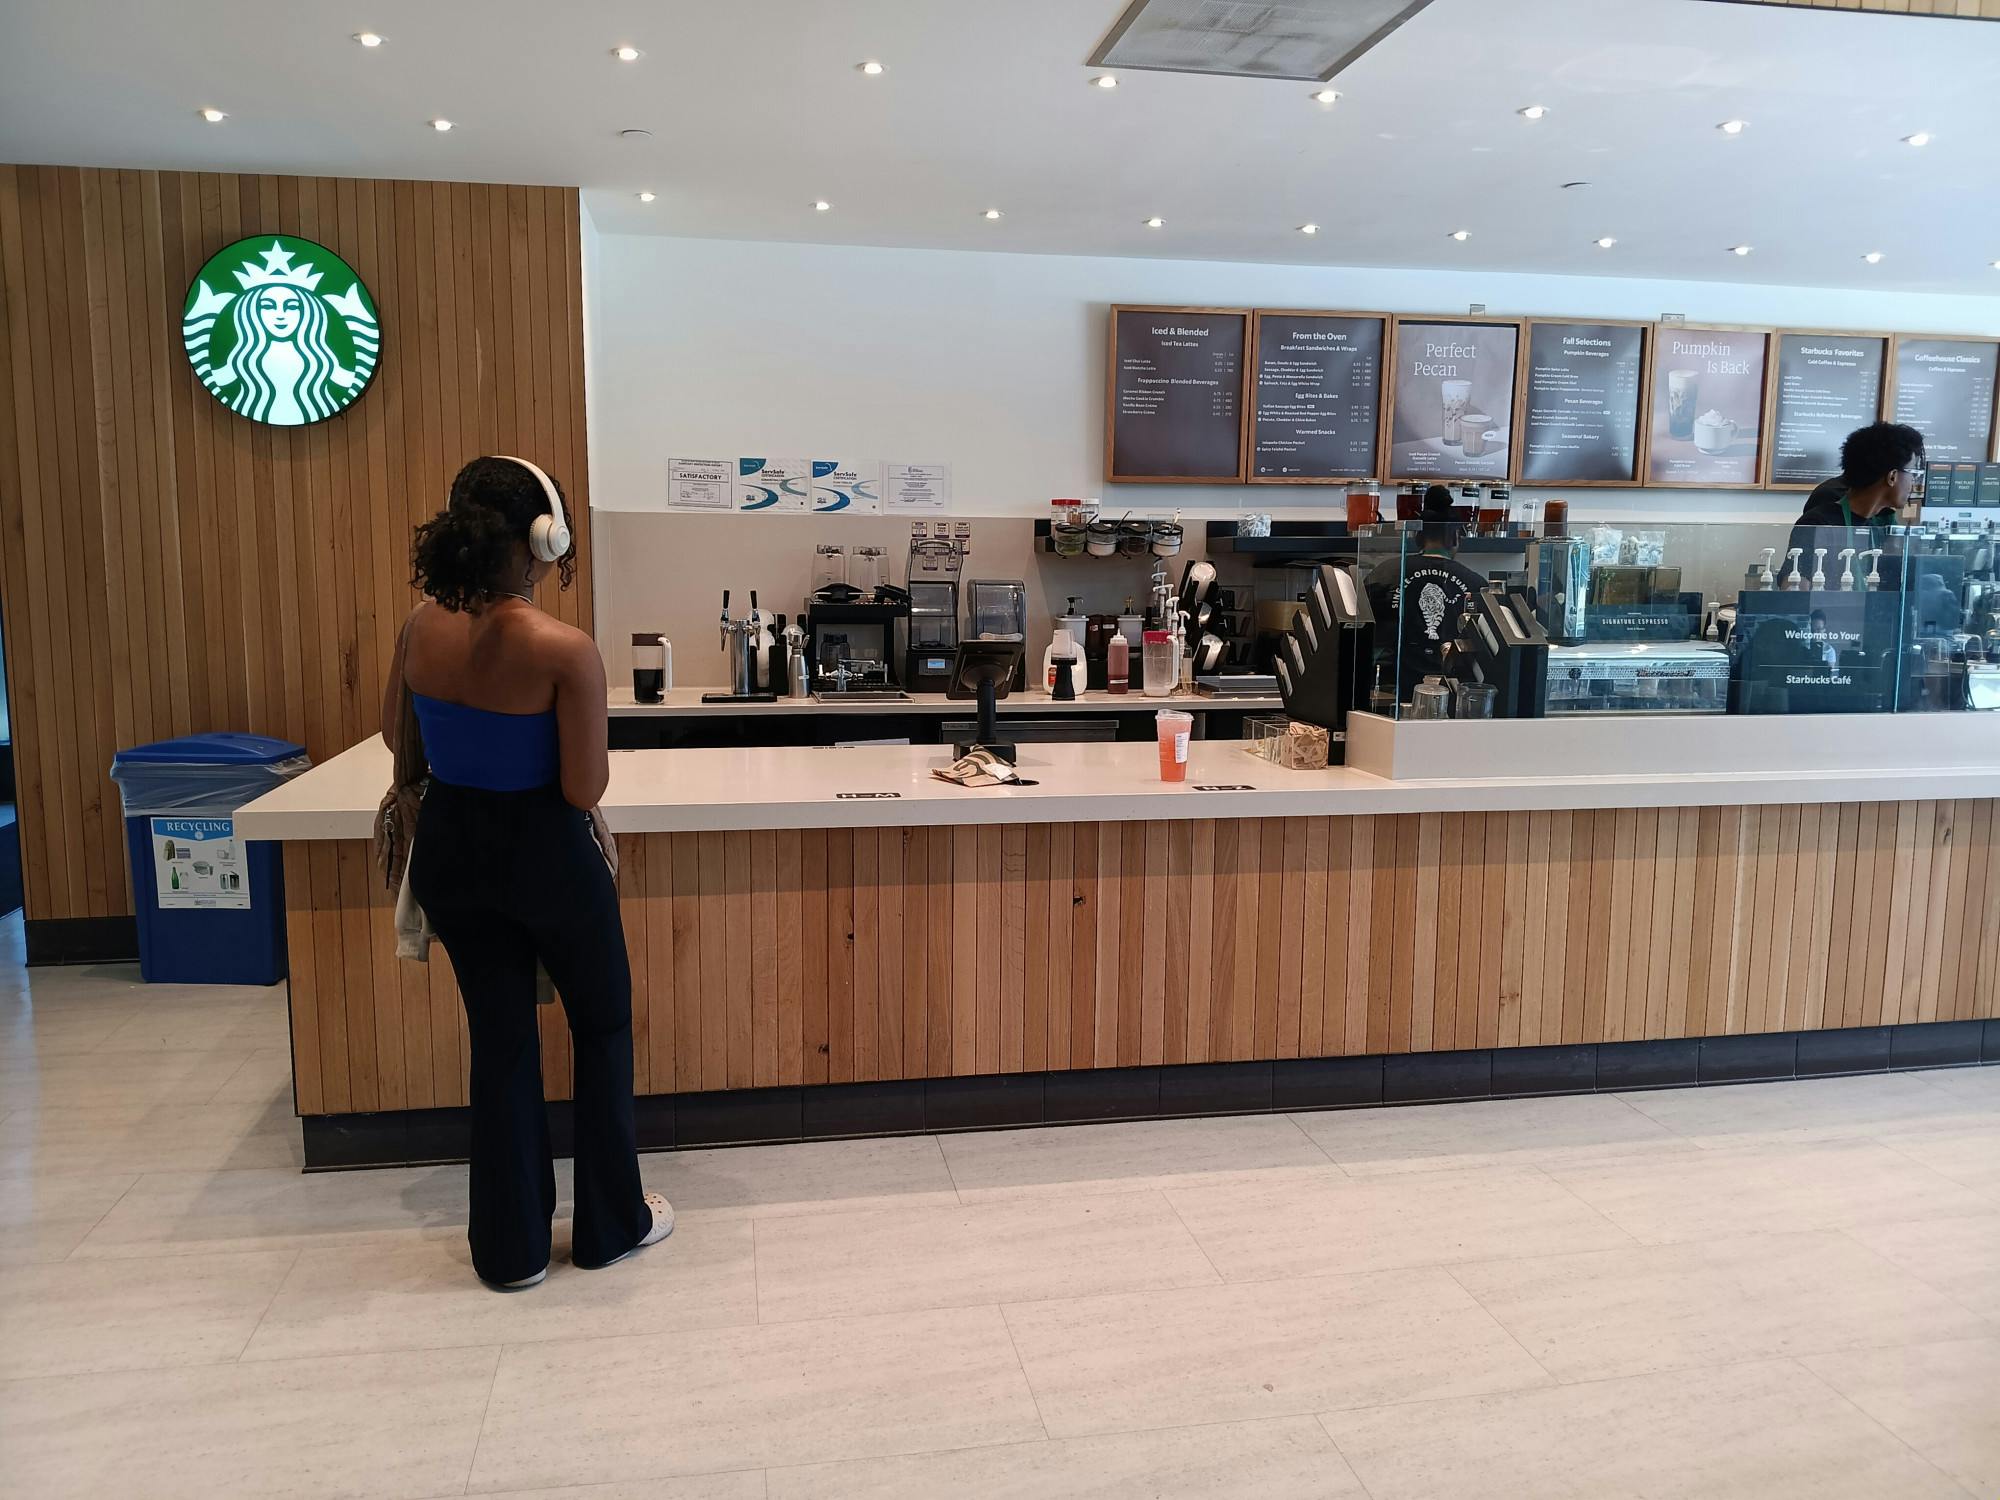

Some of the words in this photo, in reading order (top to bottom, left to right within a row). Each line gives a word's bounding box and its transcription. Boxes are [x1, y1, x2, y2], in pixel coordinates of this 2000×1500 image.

[1151, 327, 1168, 335] Iced
[1177, 328, 1209, 336] Blended
[1292, 332, 1312, 340] From
[1313, 332, 1326, 340] the
[1327, 333, 1347, 341] Oven
[1563, 337, 1575, 345] Fall
[1576, 338, 1611, 347] Selections
[1426, 343, 1476, 358] Perfect
[1672, 341, 1731, 358] Pumpkin
[1801, 347, 1833, 355] Starbucks
[1835, 348, 1864, 357] Favorites
[1914, 354, 1956, 362] Coffeehouse
[1956, 355, 1981, 364] Classics
[1414, 362, 1457, 377] Pecan
[1707, 360, 1717, 373] Is
[1720, 360, 1750, 375] Back
[1137, 377, 1169, 385] Frappuccino
[1785, 630, 1828, 640] Welcome
[1829, 631, 1839, 640] to
[1839, 631, 1860, 640] Your
[1786, 674, 1831, 684] Starbucks
[1831, 675, 1852, 685] Café
[166, 822, 230, 832] RECYCLING
